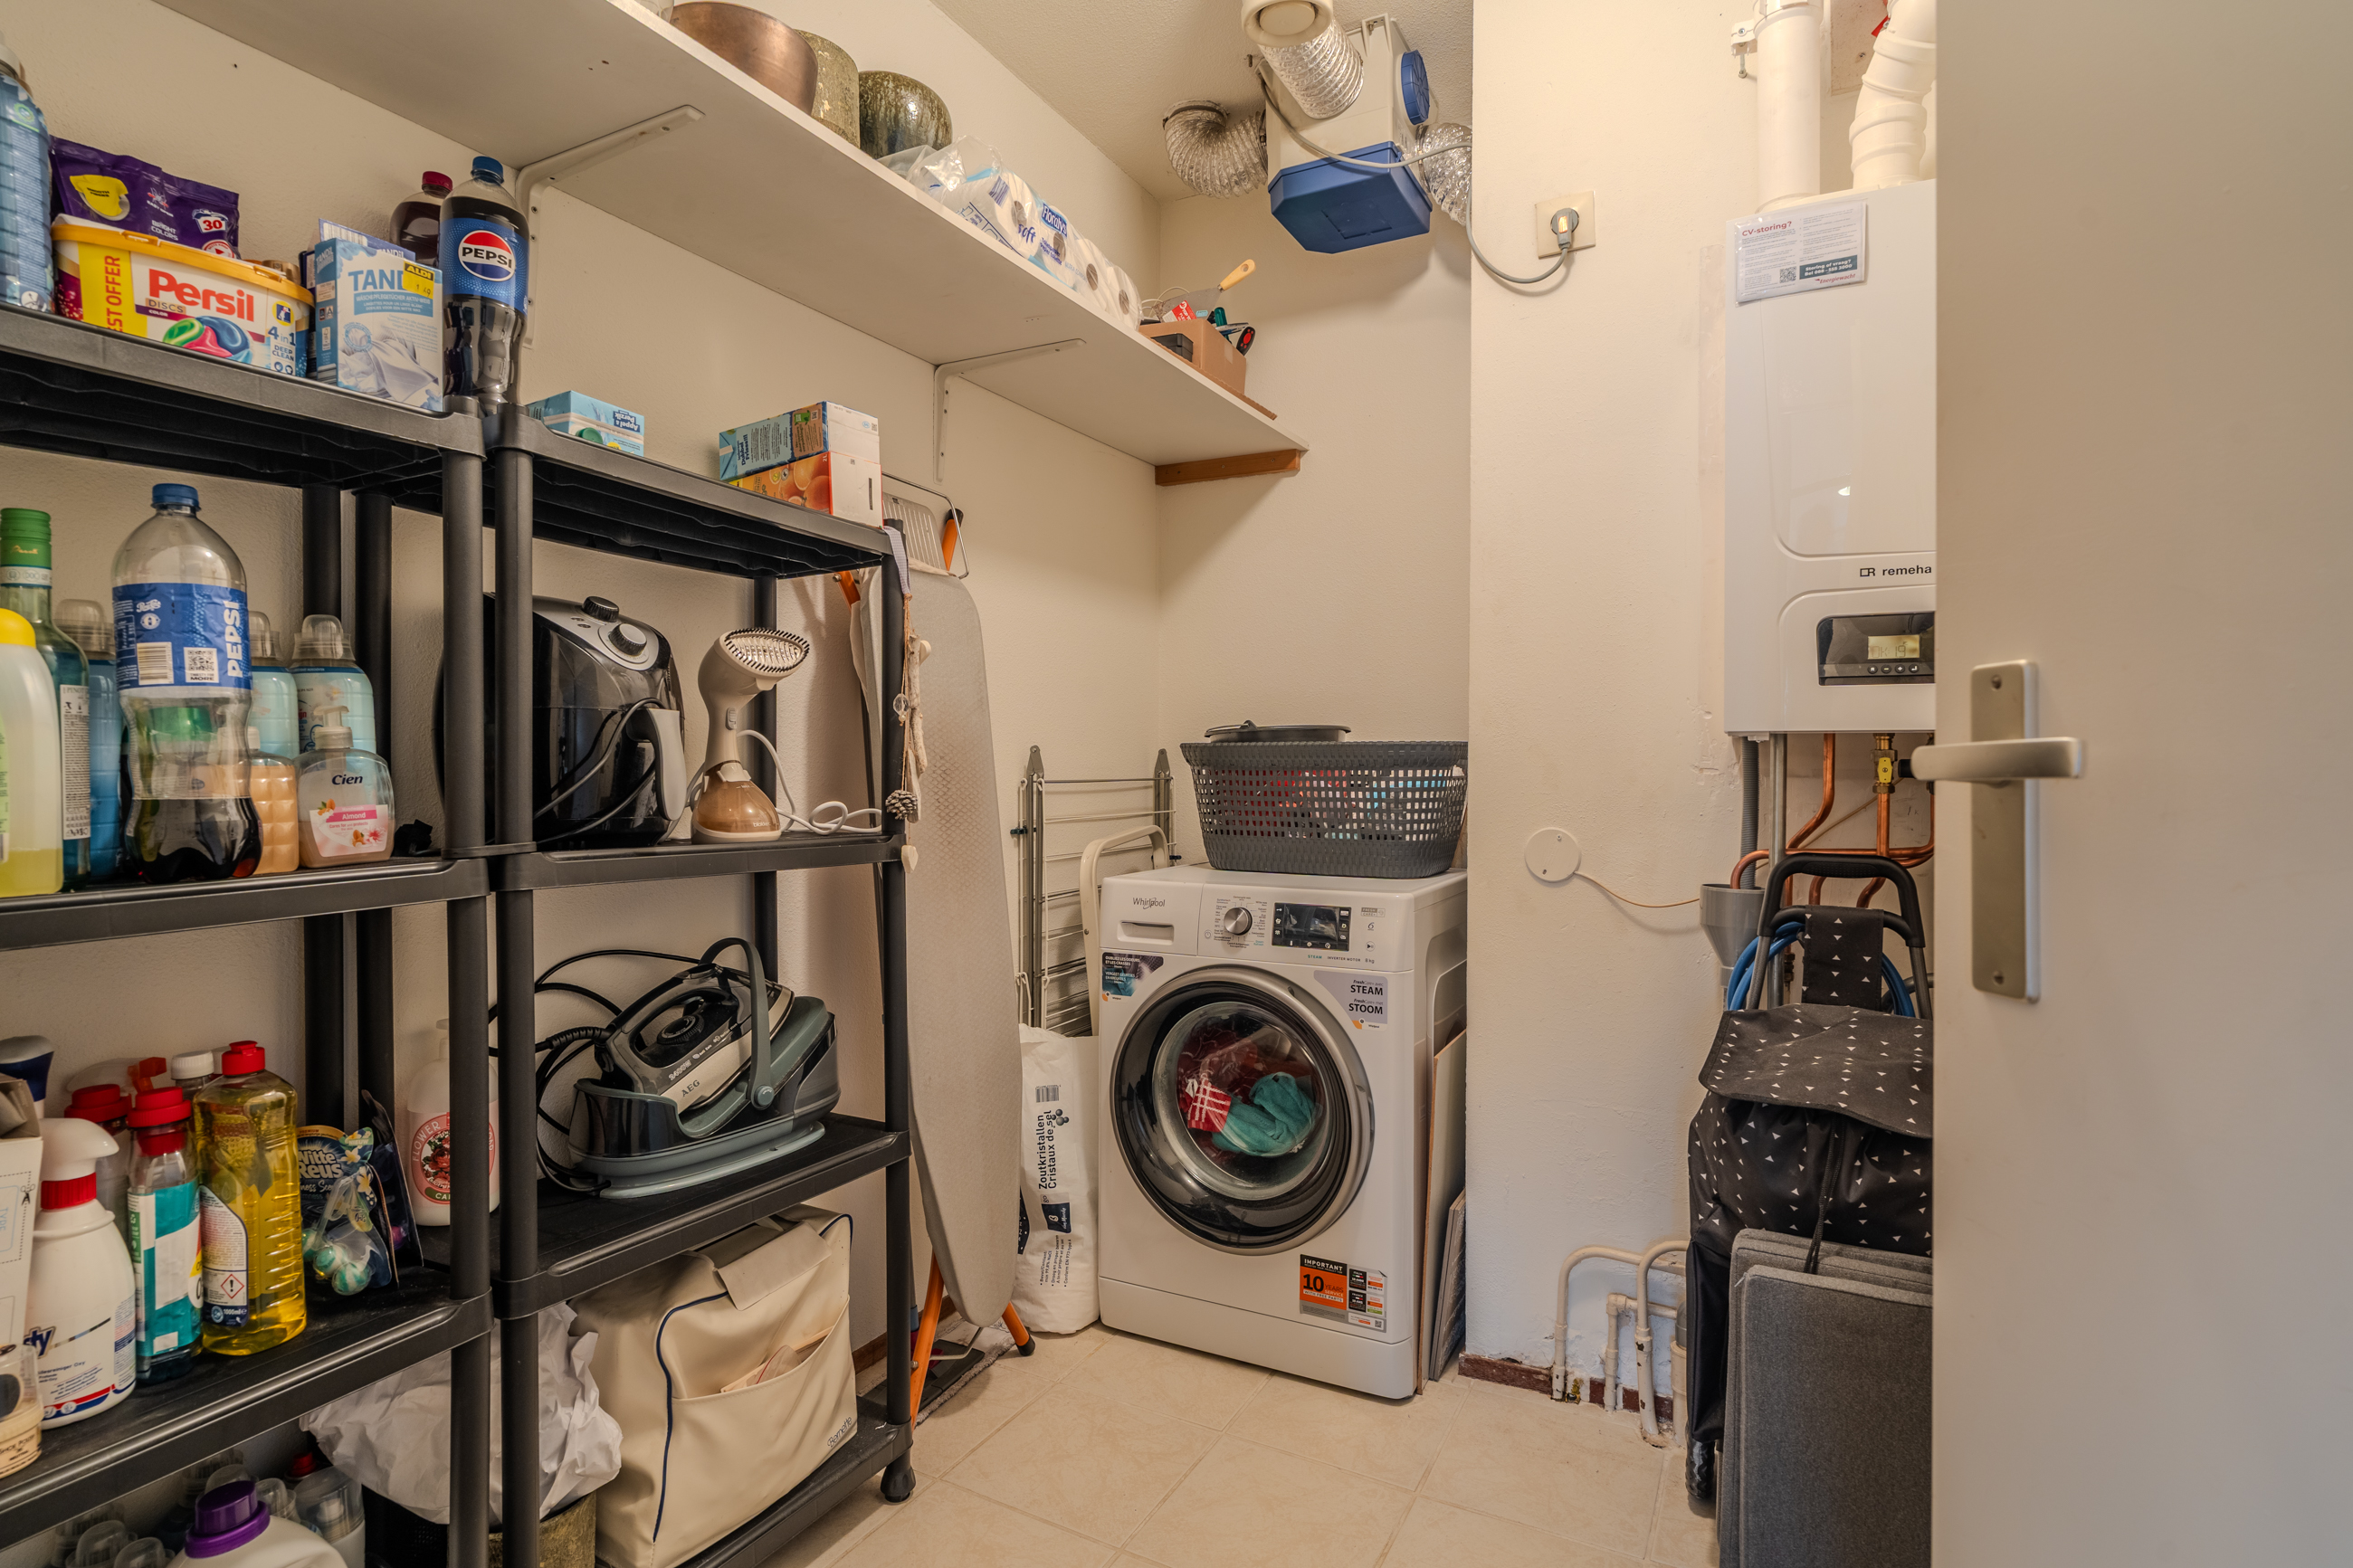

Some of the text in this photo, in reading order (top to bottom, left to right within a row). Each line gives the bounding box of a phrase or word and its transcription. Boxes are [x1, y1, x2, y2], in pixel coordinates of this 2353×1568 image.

[152, 220, 176, 233] BRIGHT
[203, 219, 223, 231] 30
[1042, 204, 1067, 237] Floralys
[151, 225, 178, 241] COLORS
[1017, 223, 1036, 243] soft
[1741, 221, 1792, 237] CV-storing?
[462, 247, 512, 269] PEPSI
[1832, 259, 1852, 267] vraag?
[105, 255, 122, 306] OFFER
[348, 270, 404, 291] TAN
[1819, 273, 1856, 284] Energiewacht
[148, 268, 254, 322] Persil
[148, 299, 184, 314] DISCS
[148, 309, 168, 317] COLOR
[272, 349, 294, 362] CLEAN
[274, 345, 292, 355] DEEP
[614, 412, 635, 423] Perzik
[620, 421, 639, 432] Appel
[1882, 565, 1932, 575] remeha
[224, 600, 243, 678] PEPSI
[331, 774, 364, 785] Cien
[342, 812, 366, 820] Almond
[1133, 897, 1166, 909] Whirlpool
[1350, 984, 1383, 995] STEAM
[1348, 1003, 1383, 1014] STOOM
[681, 1079, 700, 1098] AEG
[412, 1120, 442, 1162] FLOWER
[1036, 1115, 1047, 1190] Zoutkristallen
[1044, 1110, 1057, 1189] Cristaux de sel
[300, 1162, 343, 1179] Reus
[1304, 1258, 1343, 1271] IMPORTANT
[1303, 1273, 1324, 1292] 10
[1325, 1284, 1344, 1293] YEARS
[1325, 1289, 1344, 1297] SERVICE
